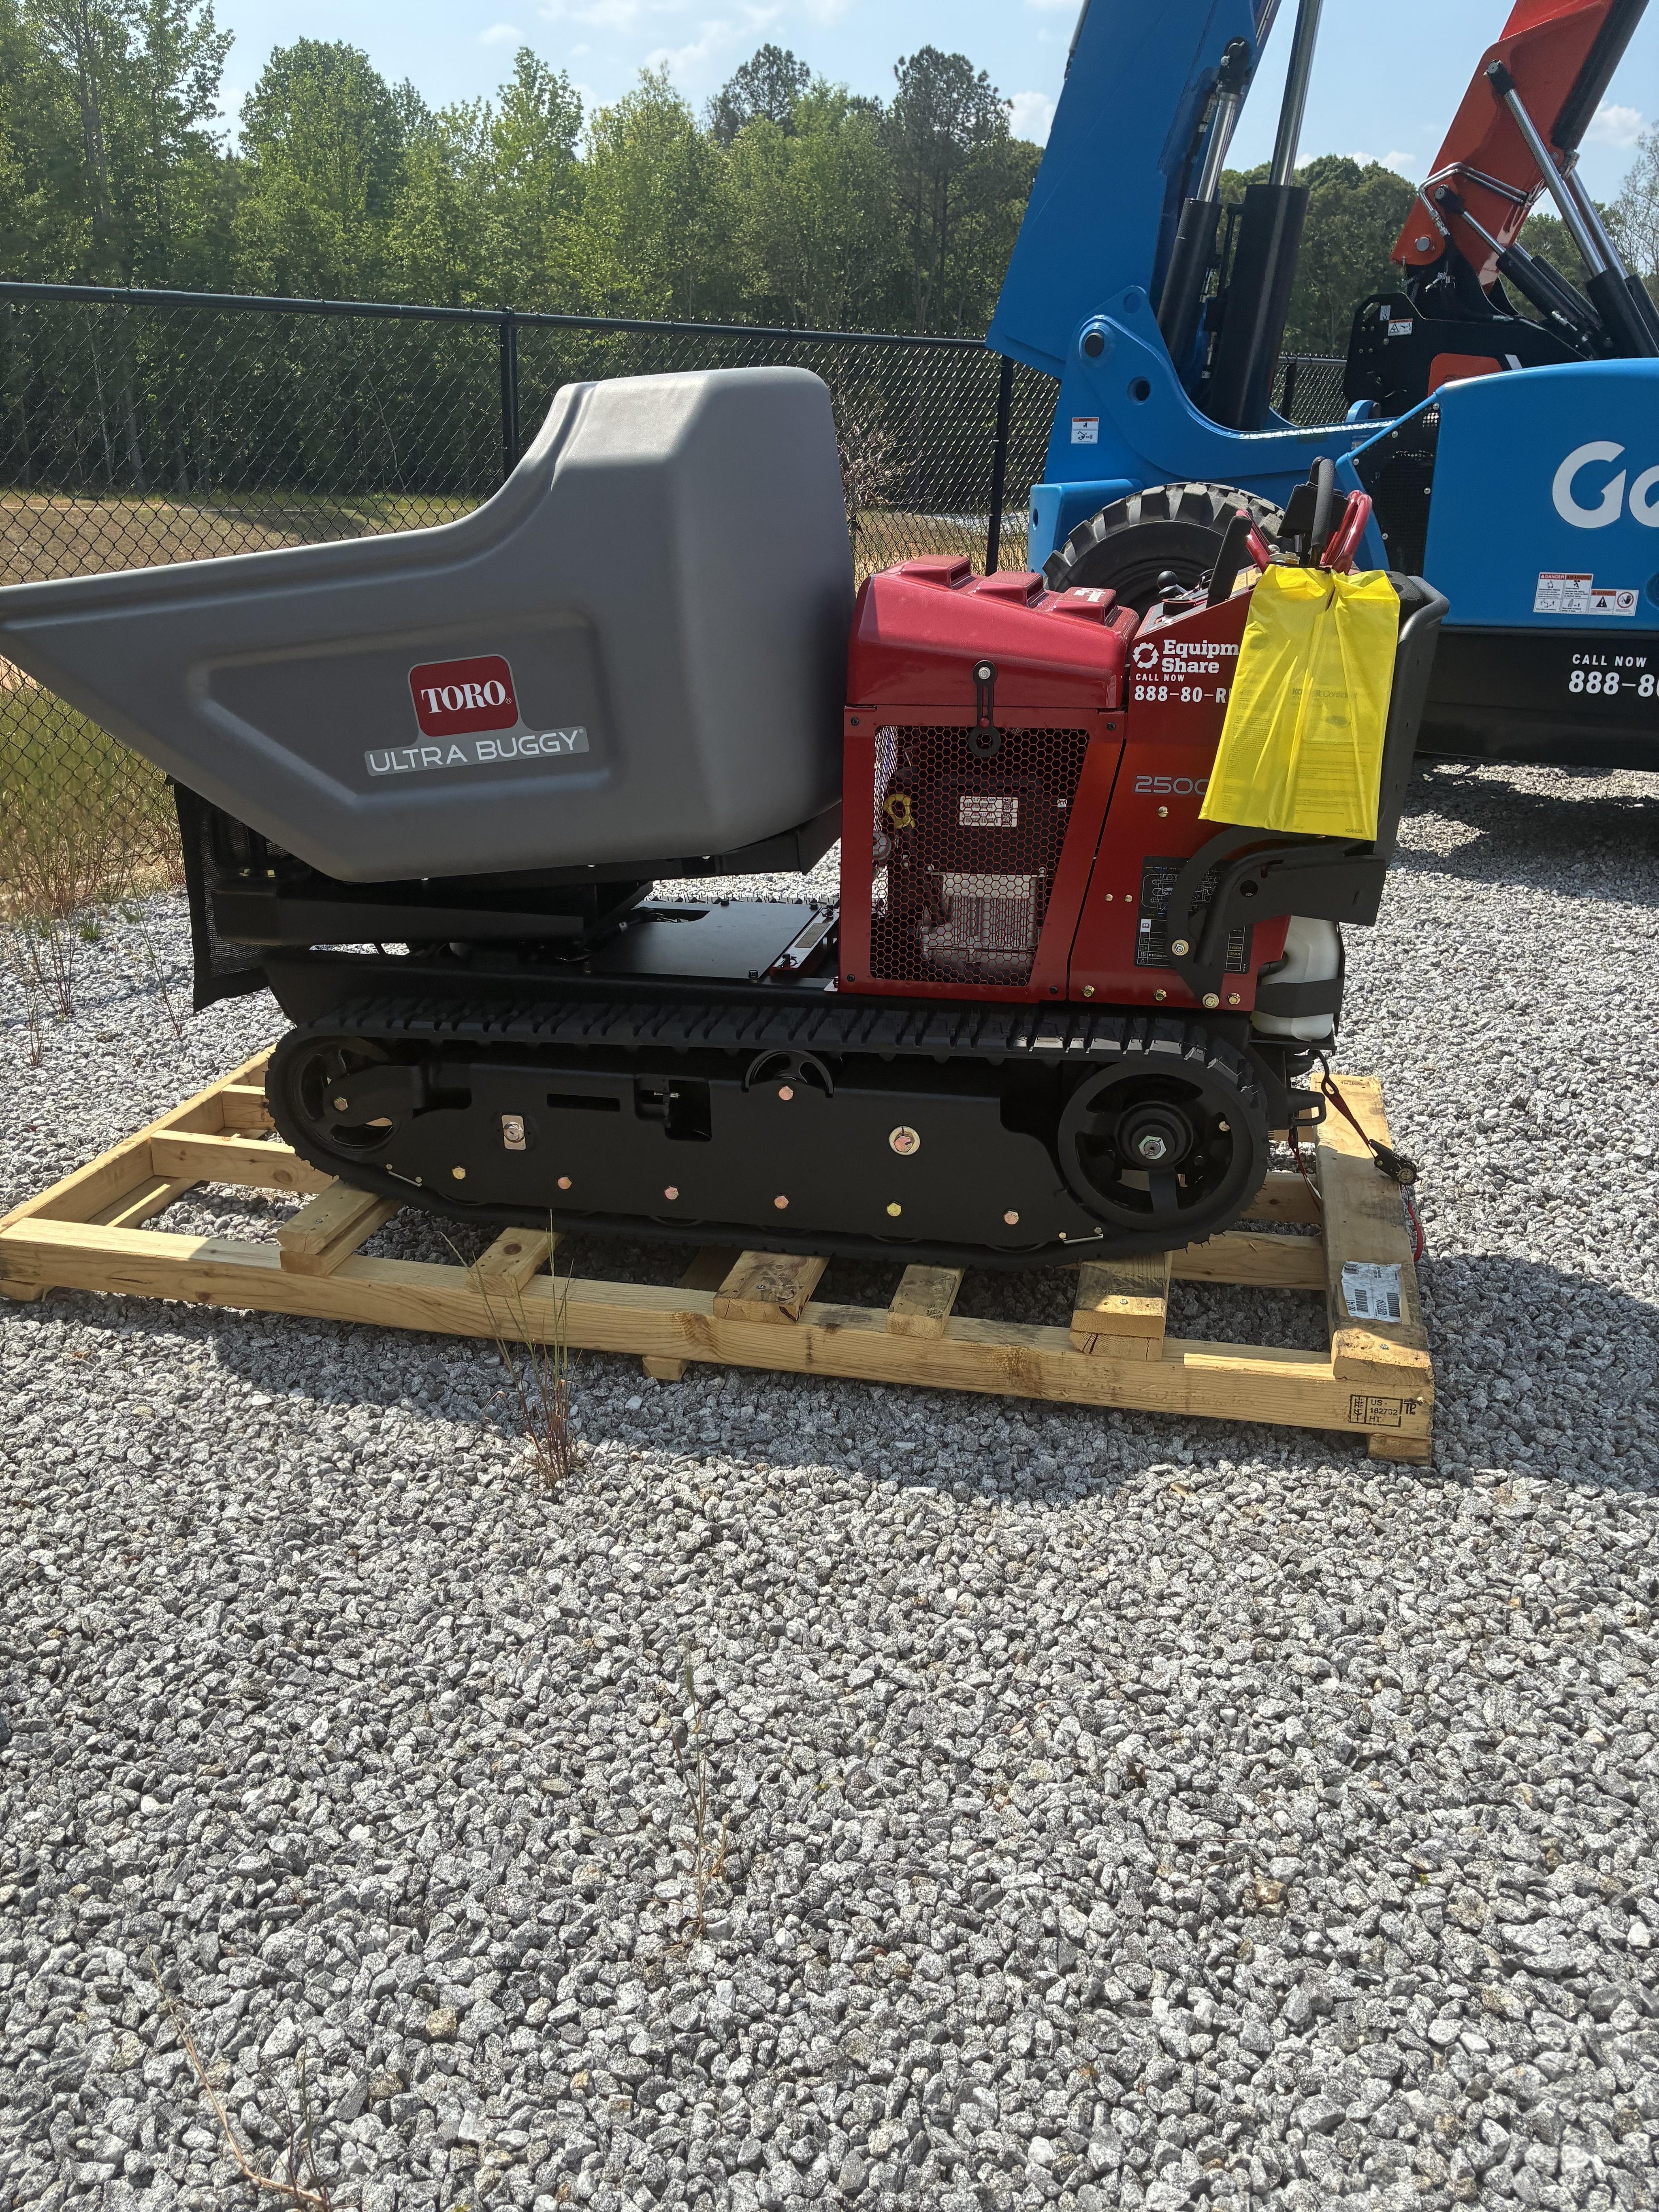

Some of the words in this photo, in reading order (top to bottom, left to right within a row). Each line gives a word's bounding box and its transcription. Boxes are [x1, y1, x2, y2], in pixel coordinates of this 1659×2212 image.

[1163, 639, 1239, 659] Equipm
[1162, 657, 1219, 673] Share
[1572, 654, 1607, 666] CALL
[1614, 656, 1646, 668] NOW
[1136, 673, 1159, 681] CALL
[1569, 670, 1659, 697] 888-8
[421, 680, 506, 713] TORO
[1134, 685, 1231, 703] 888-80-R
[369, 744, 468, 772] ULTRA
[476, 730, 578, 761] BUGGY
